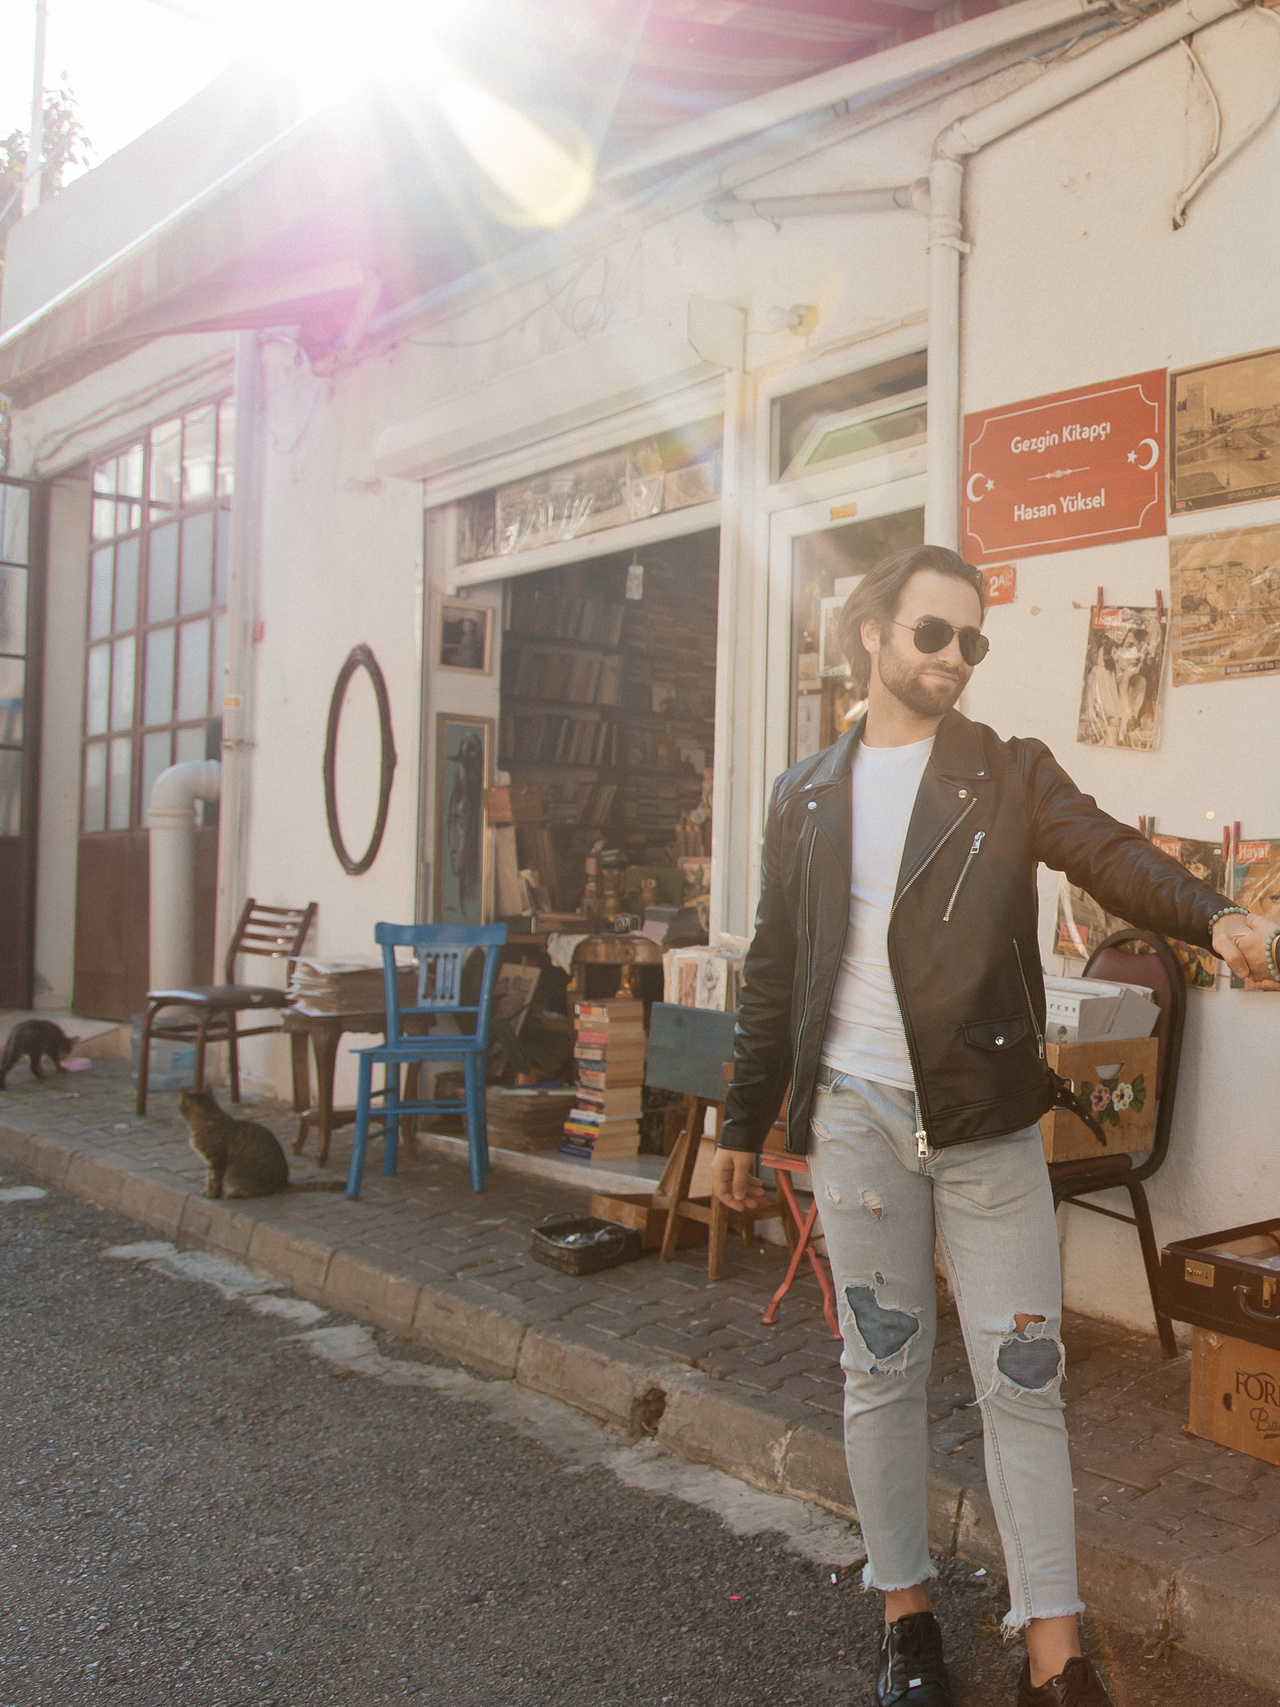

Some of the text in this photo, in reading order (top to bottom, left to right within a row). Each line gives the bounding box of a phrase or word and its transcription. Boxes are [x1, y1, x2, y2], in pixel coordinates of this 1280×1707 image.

[1010, 421, 1111, 454] Gezgin Kitapçı
[1014, 487, 1105, 522] Hasan Yüksel
[1238, 844, 1269, 861] Hayat
